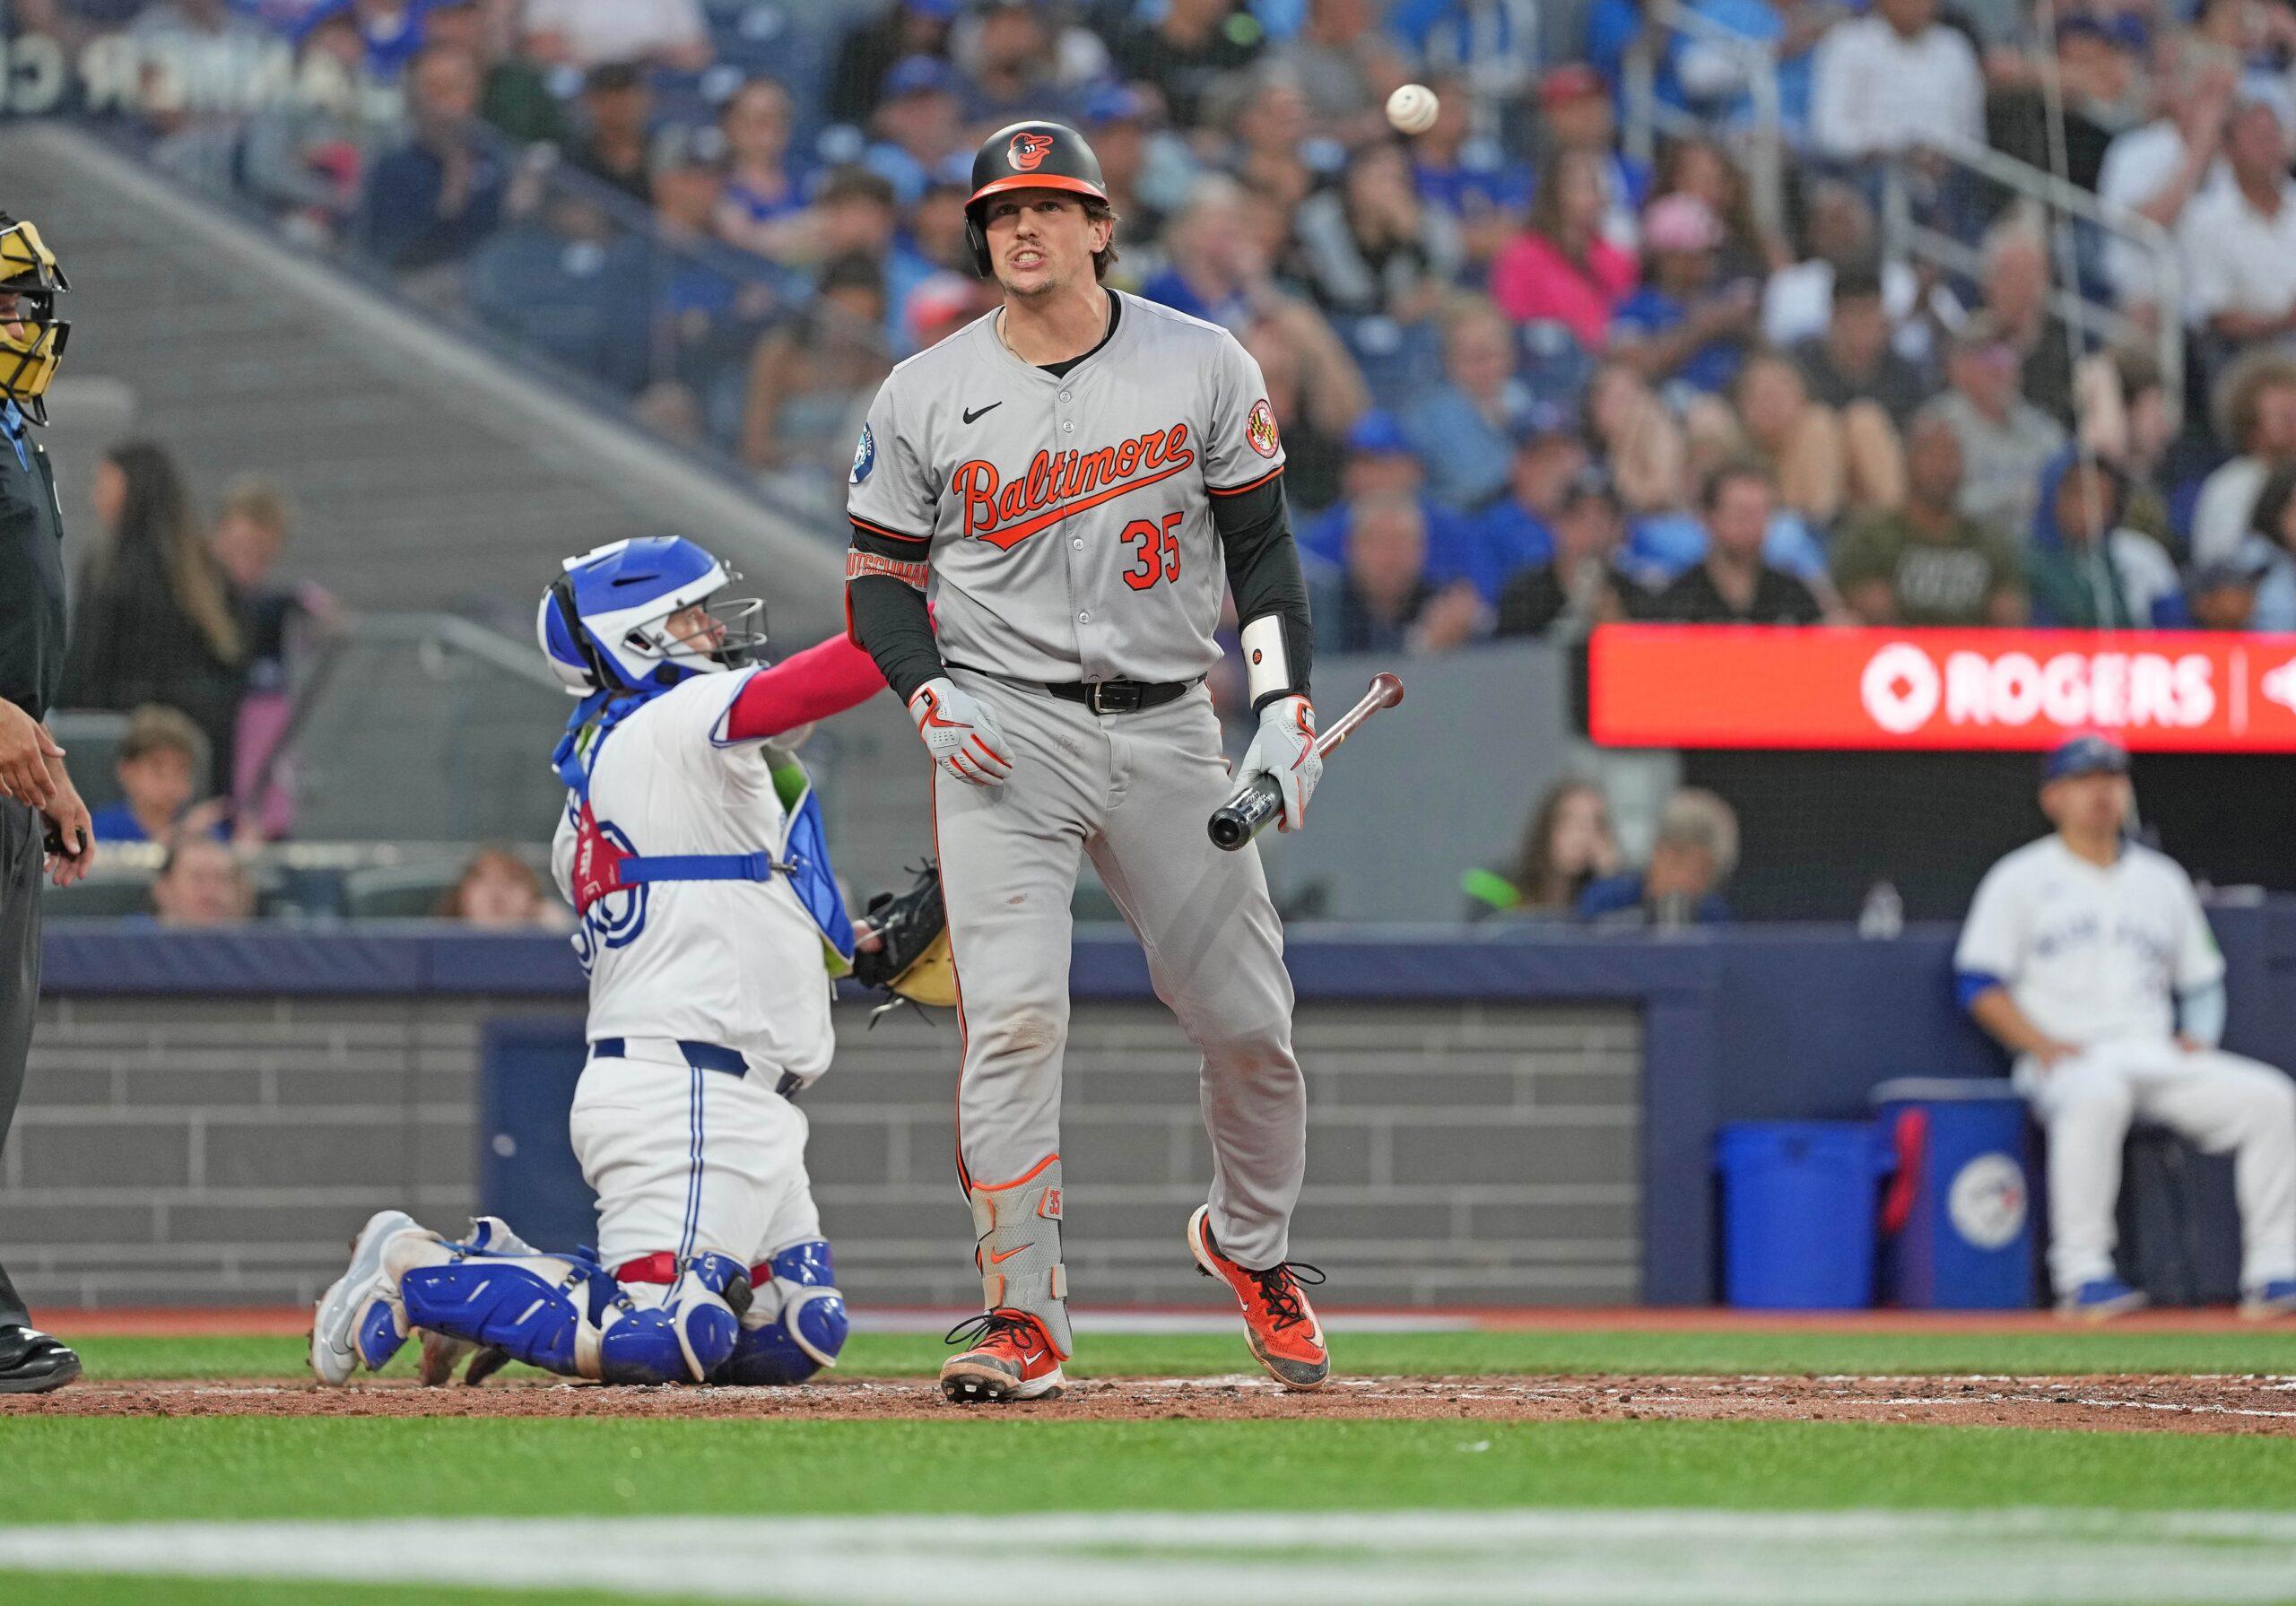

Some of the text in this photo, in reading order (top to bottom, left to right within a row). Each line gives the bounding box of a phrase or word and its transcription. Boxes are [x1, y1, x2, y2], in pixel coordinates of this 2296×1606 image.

[952, 423, 1194, 539] Baltimore
[1121, 510, 1185, 592] 35
[1944, 652, 2217, 728] ROGERS
